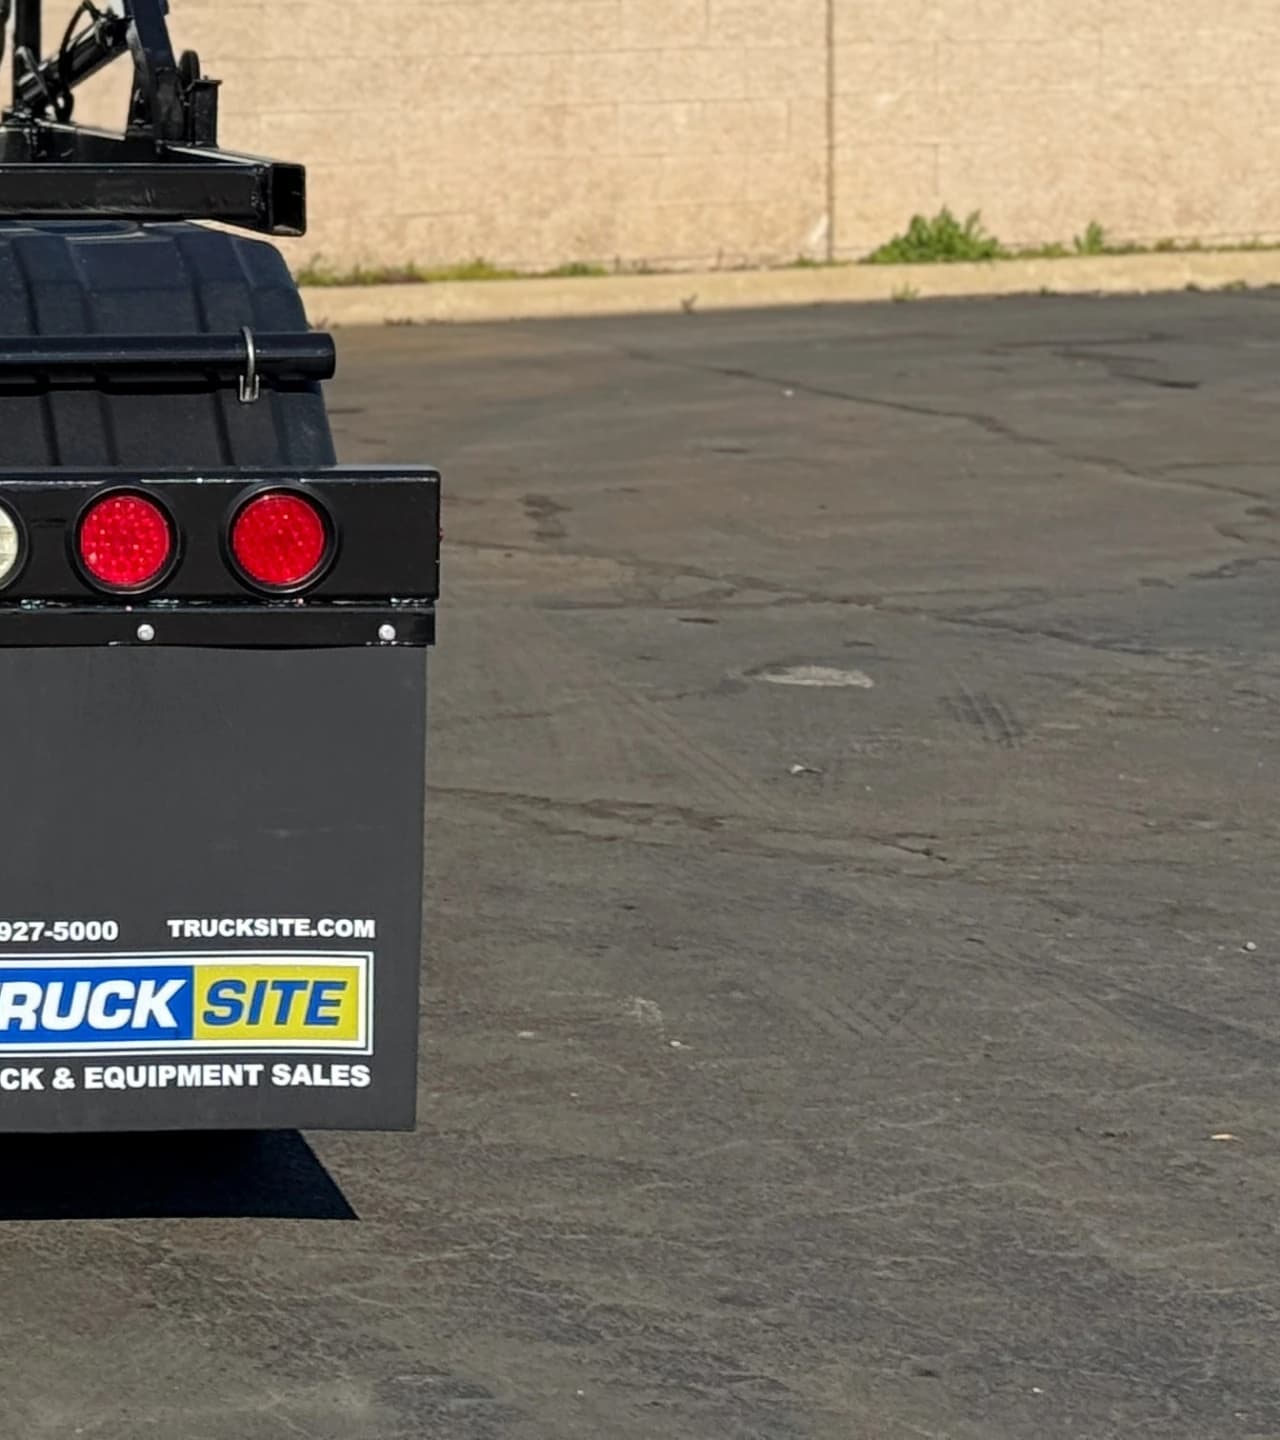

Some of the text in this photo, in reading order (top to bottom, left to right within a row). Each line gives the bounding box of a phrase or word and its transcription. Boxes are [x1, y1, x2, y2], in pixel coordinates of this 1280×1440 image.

[167, 918, 376, 939] TRUCKSITE.COM
[202, 979, 348, 1027] SITE
[52, 1067, 76, 1090] &
[84, 1064, 264, 1090] EQUIPMENT
[272, 1063, 371, 1087] SALES
